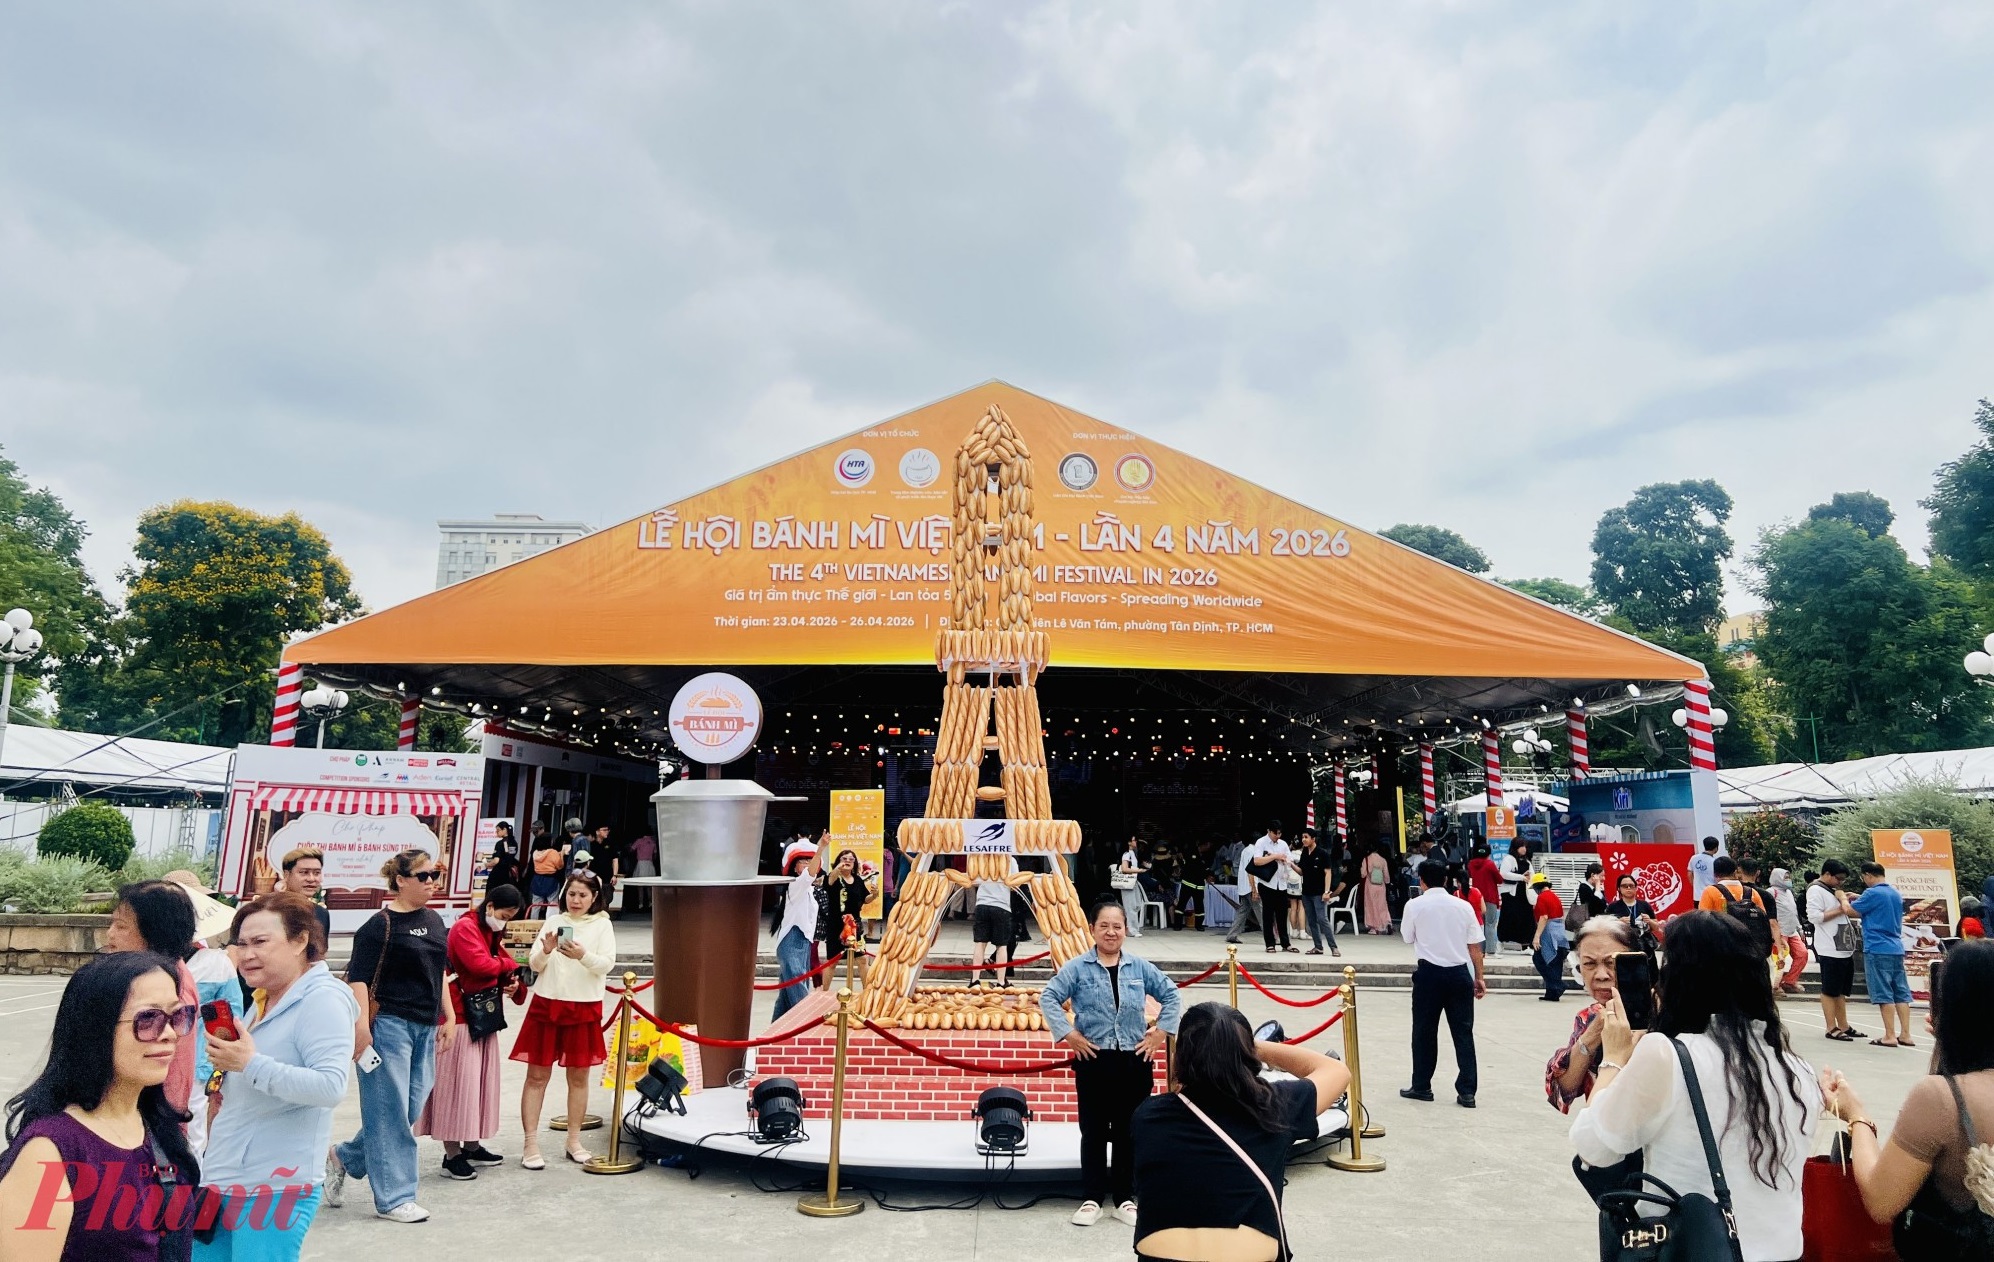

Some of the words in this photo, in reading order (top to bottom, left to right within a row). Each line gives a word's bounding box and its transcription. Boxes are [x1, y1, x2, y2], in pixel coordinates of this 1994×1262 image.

[847, 460, 865, 468] HTA
[638, 508, 679, 550] LỄ
[682, 515, 742, 555] HỘI
[752, 515, 839, 550] BÁNH
[850, 513, 891, 549] MÌ
[1080, 511, 1141, 552] LẦN
[1152, 525, 1174, 552] 4
[1185, 519, 1259, 555] NĂM
[1270, 528, 1351, 557] 2026
[768, 563, 804, 582] THE
[843, 563, 952, 582] VIETNAMES
[1054, 565, 1138, 584] FESTIVAL
[1143, 567, 1163, 585] IN
[1168, 568, 1219, 586] 2026
[724, 588, 746, 601] Giá
[749, 589, 763, 604] trị
[766, 585, 788, 601] ẩm
[792, 589, 822, 603] thực
[825, 586, 851, 601] Thế
[853, 588, 877, 604] giới
[890, 589, 914, 601] Lan
[918, 587, 940, 601] tỏa
[1034, 591, 1057, 603] bal
[1060, 591, 1108, 604] Flavors
[1120, 592, 1189, 608] Spreading
[1193, 594, 1263, 607] Worldwide
[714, 615, 739, 627] Thời
[741, 616, 770, 629] gian:
[773, 616, 838, 627] 23.04.2026
[850, 616, 915, 627] 26.04.2026
[1033, 616, 1052, 628] iên
[1053, 617, 1067, 628] Lê
[1070, 617, 1092, 629] Văn
[1094, 617, 1122, 631] Tám,
[1124, 619, 1168, 633] phường
[1170, 620, 1191, 631] Tân
[1193, 621, 1223, 634] Định,
[1226, 622, 1244, 633] TP.
[1247, 623, 1274, 633] HCM
[689, 717, 720, 730] BÁNH
[724, 717, 738, 730] MÌ
[1896, 876, 1938, 885] FRANCHISE
